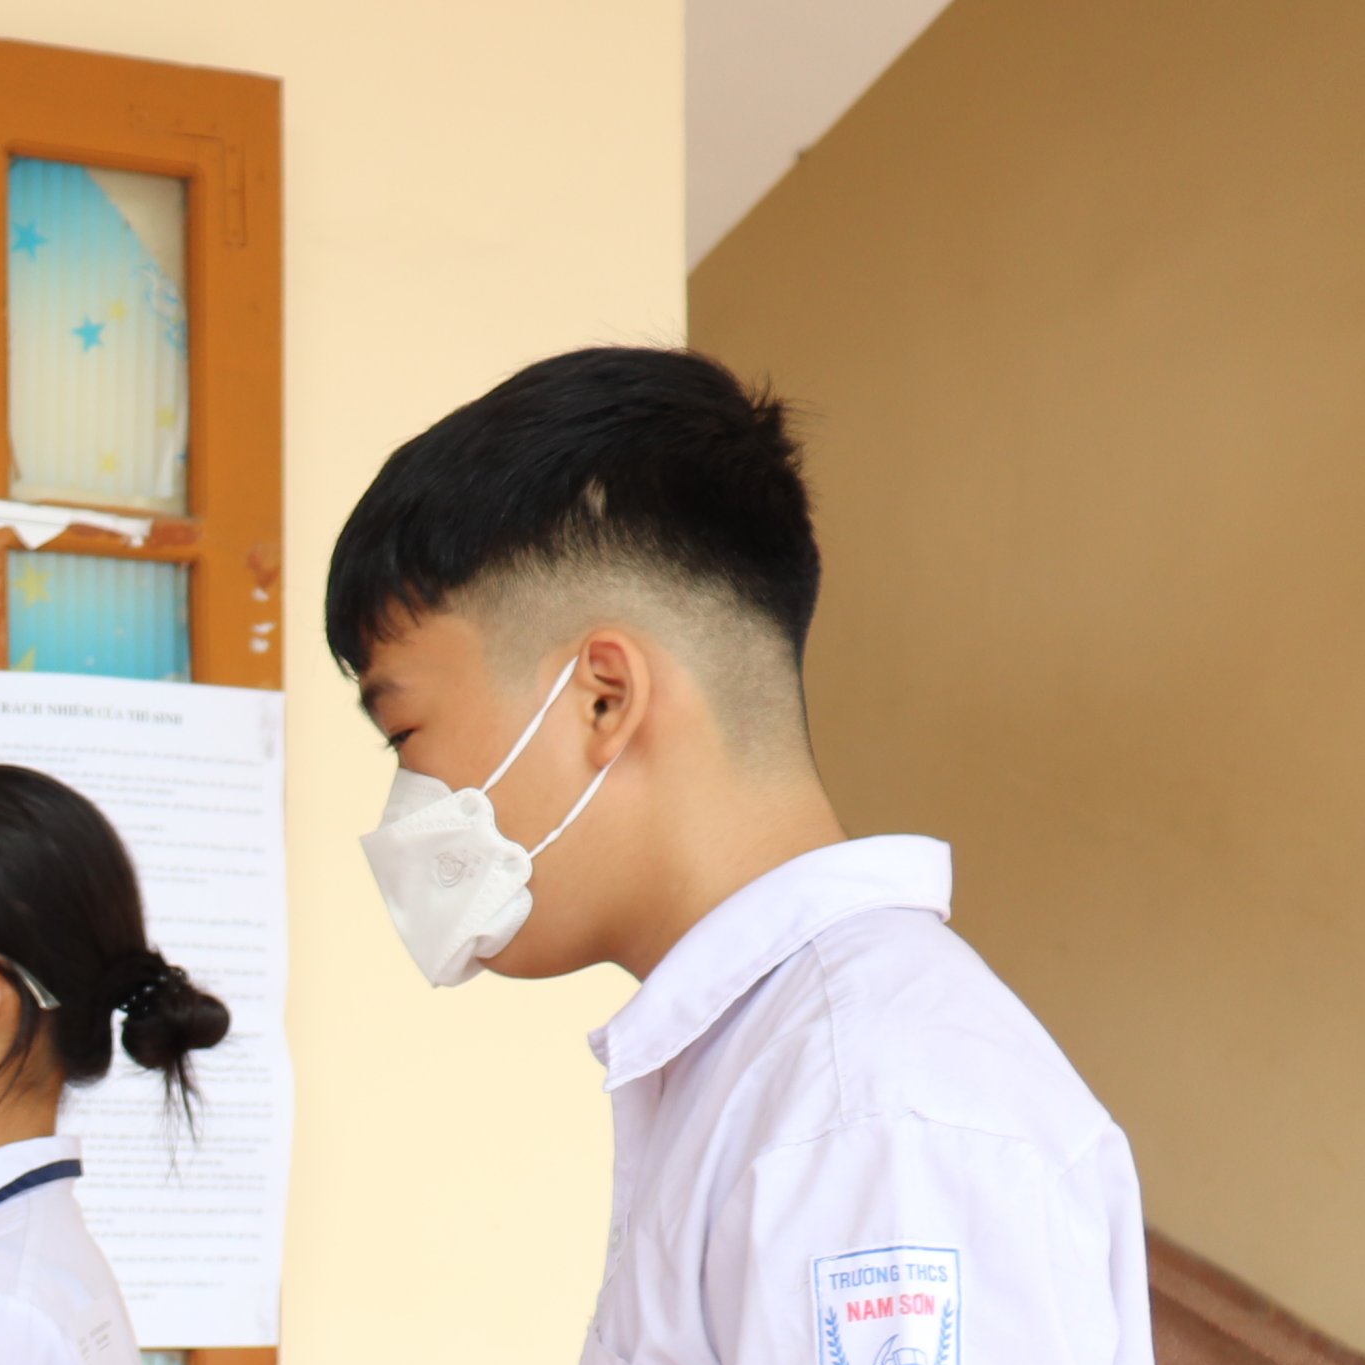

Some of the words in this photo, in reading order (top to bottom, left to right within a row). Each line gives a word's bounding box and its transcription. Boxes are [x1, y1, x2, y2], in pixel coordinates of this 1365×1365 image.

[905, 1263, 948, 1282] THCS
[846, 1296, 894, 1323] NAM
[898, 1292, 936, 1316] SƠN
